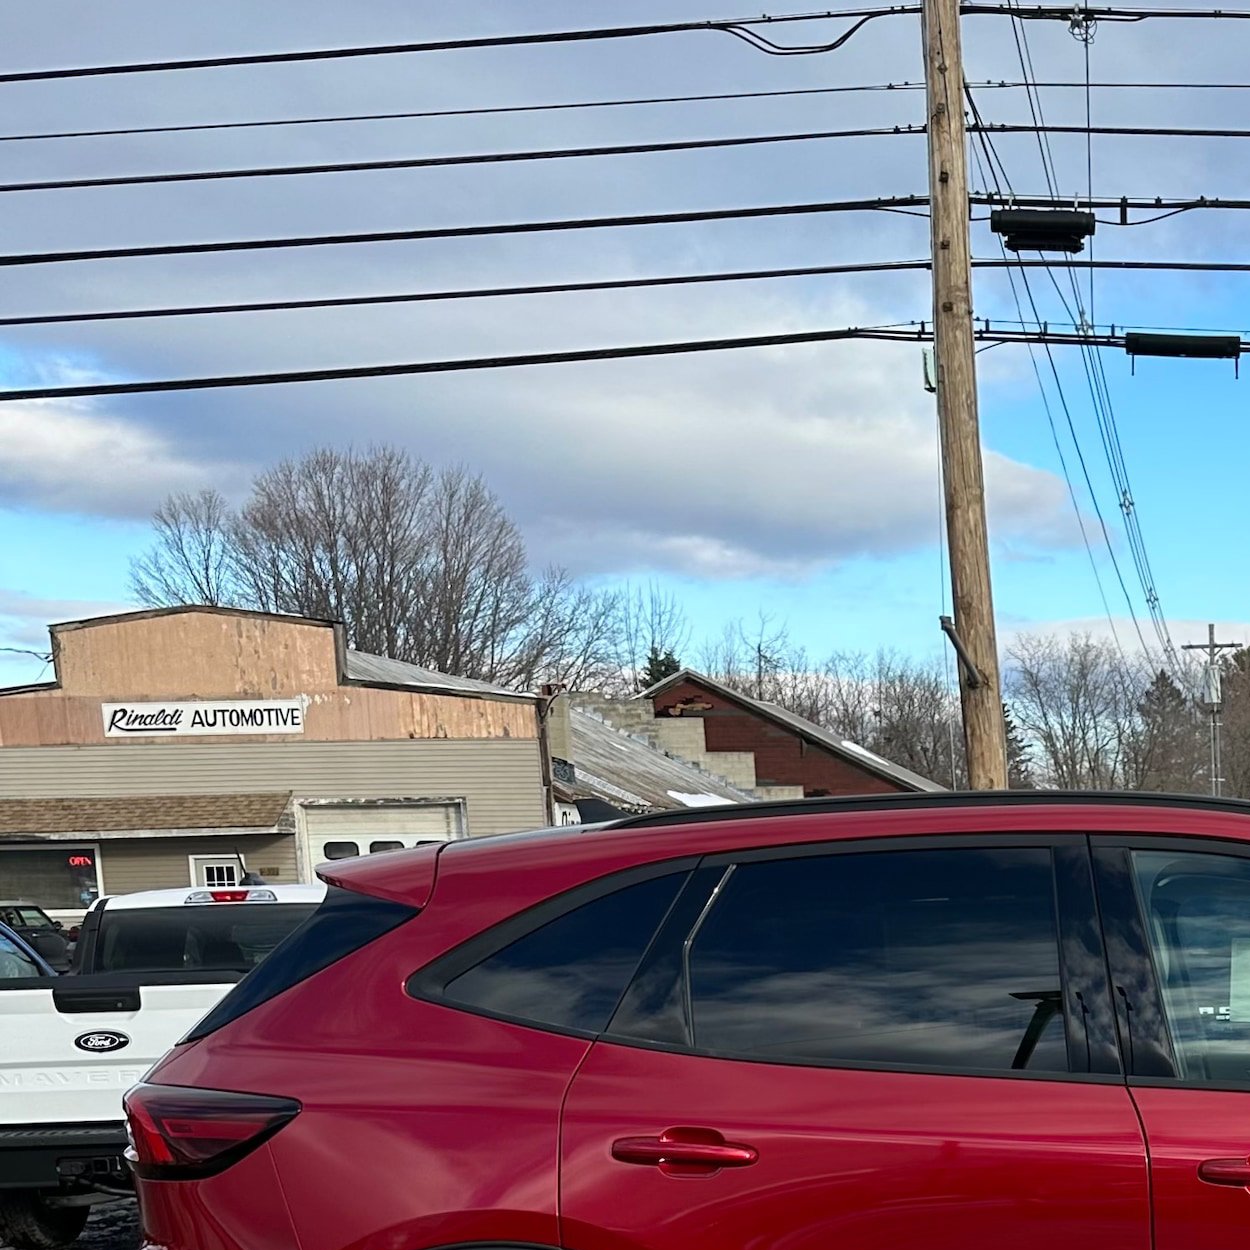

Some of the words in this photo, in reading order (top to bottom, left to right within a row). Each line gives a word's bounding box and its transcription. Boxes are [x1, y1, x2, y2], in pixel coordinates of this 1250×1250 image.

[109, 708, 183, 732] Rinaldi
[191, 708, 301, 728] AUTOMOTIVE
[69, 856, 92, 866] OPEN
[88, 1036, 111, 1047] Ford
